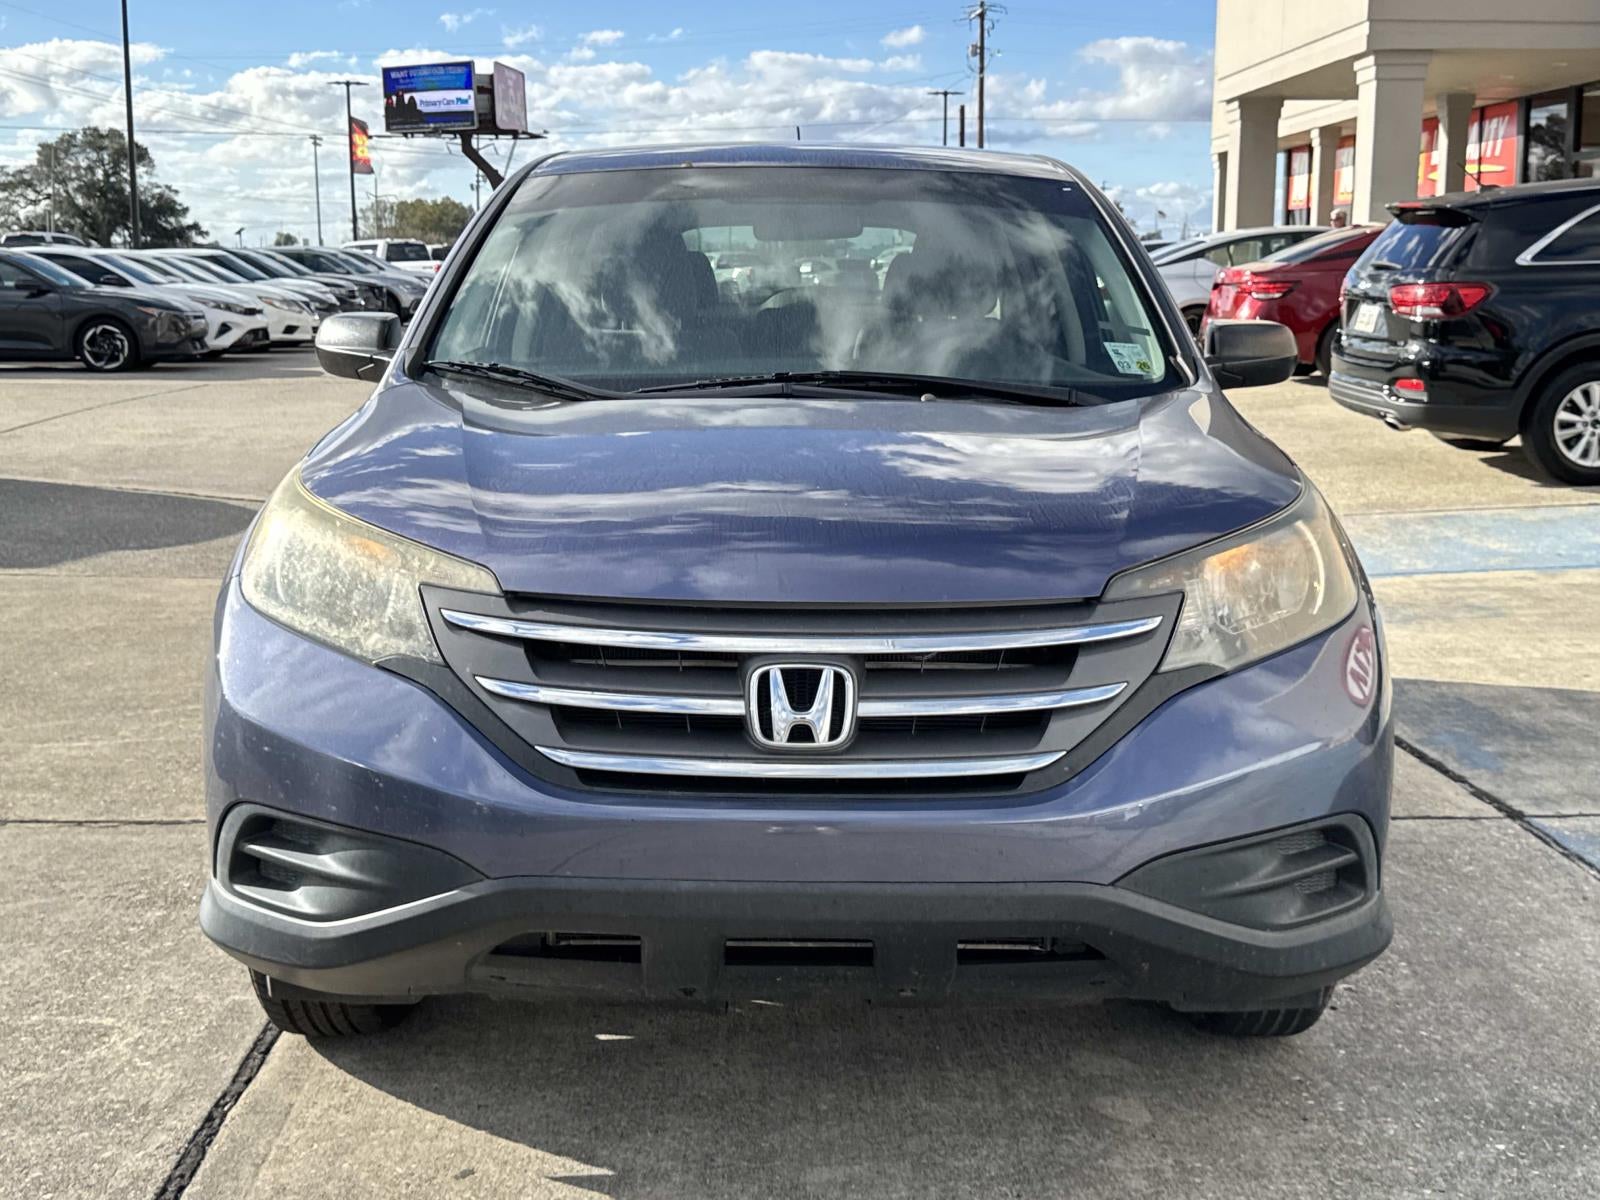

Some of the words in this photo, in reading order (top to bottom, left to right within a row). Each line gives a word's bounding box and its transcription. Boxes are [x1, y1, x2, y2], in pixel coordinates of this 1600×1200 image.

[419, 99, 441, 108] Primary
[442, 97, 455, 106] Care
[456, 96, 469, 105] Plus
